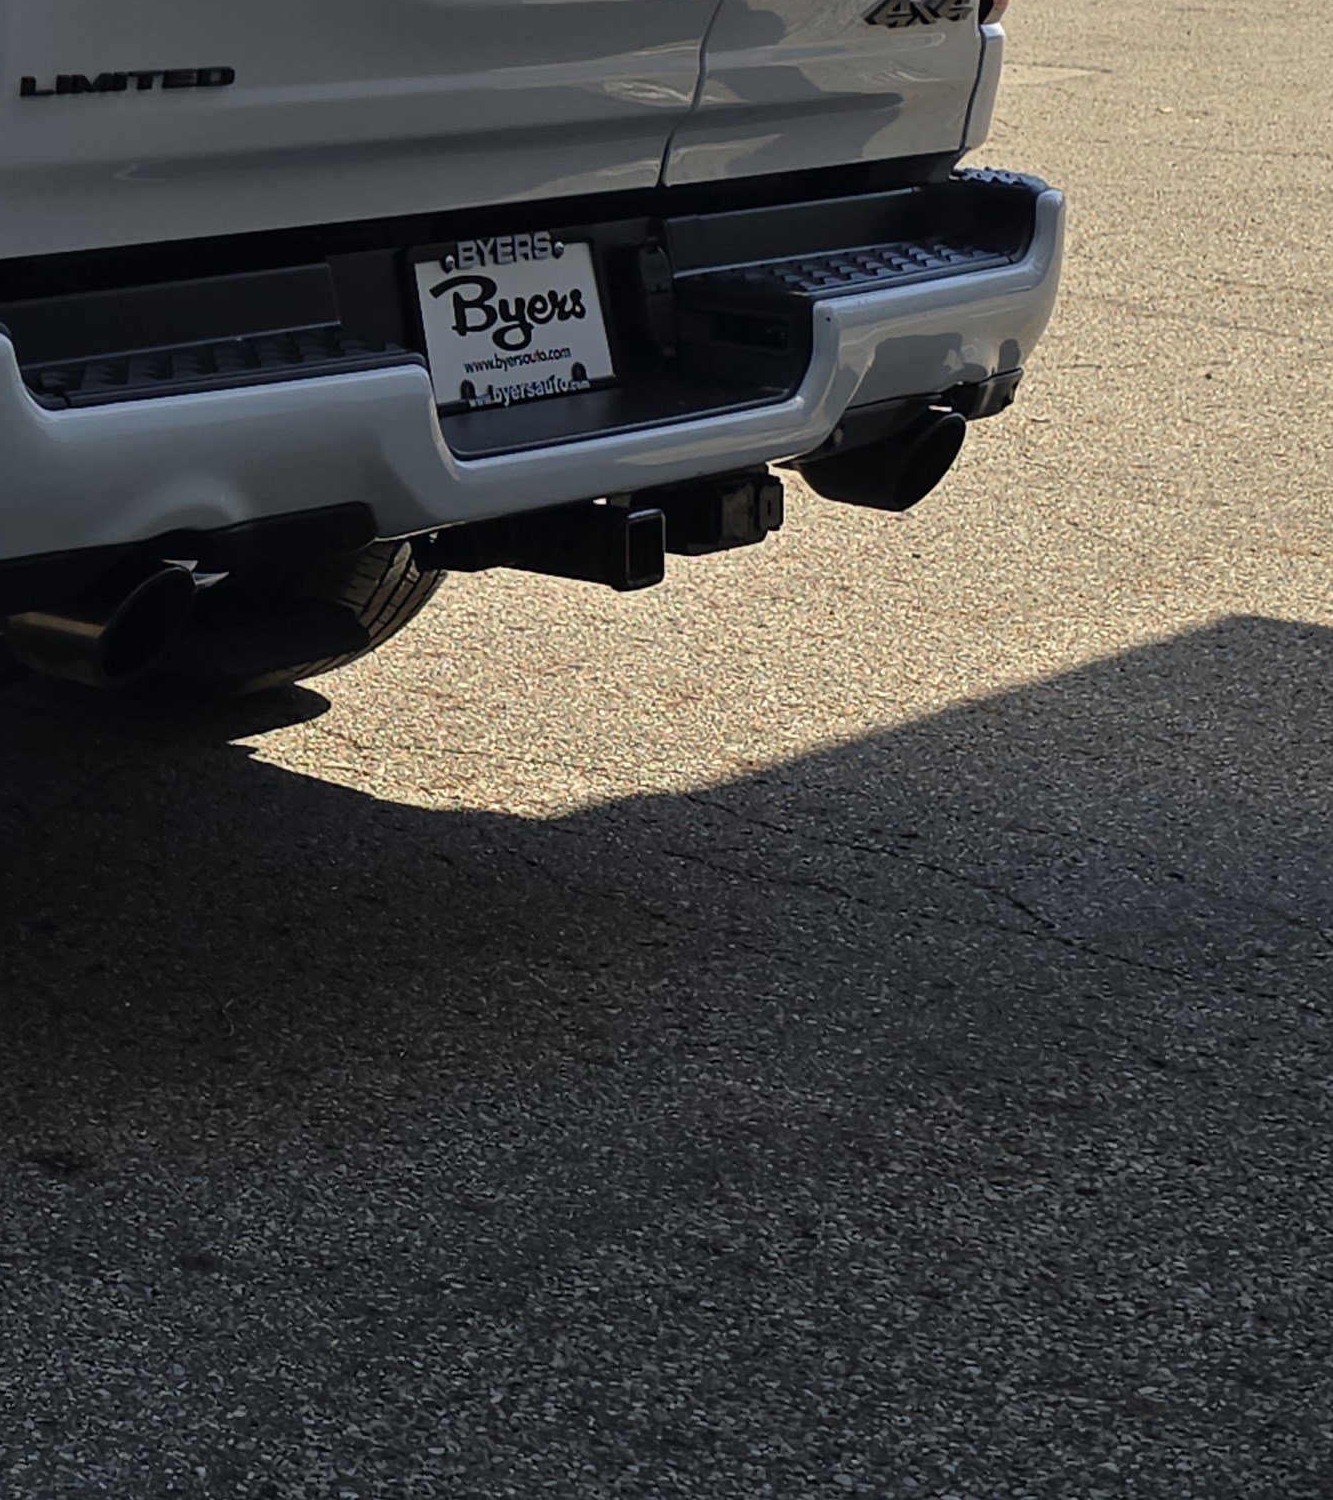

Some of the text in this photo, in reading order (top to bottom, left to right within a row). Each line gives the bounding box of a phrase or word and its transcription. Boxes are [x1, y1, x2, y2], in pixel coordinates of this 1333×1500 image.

[20, 66, 235, 96] LIMITED
[456, 231, 552, 270] BYERS
[429, 275, 586, 351] Byers
[463, 346, 572, 374] www.byersauto.com
